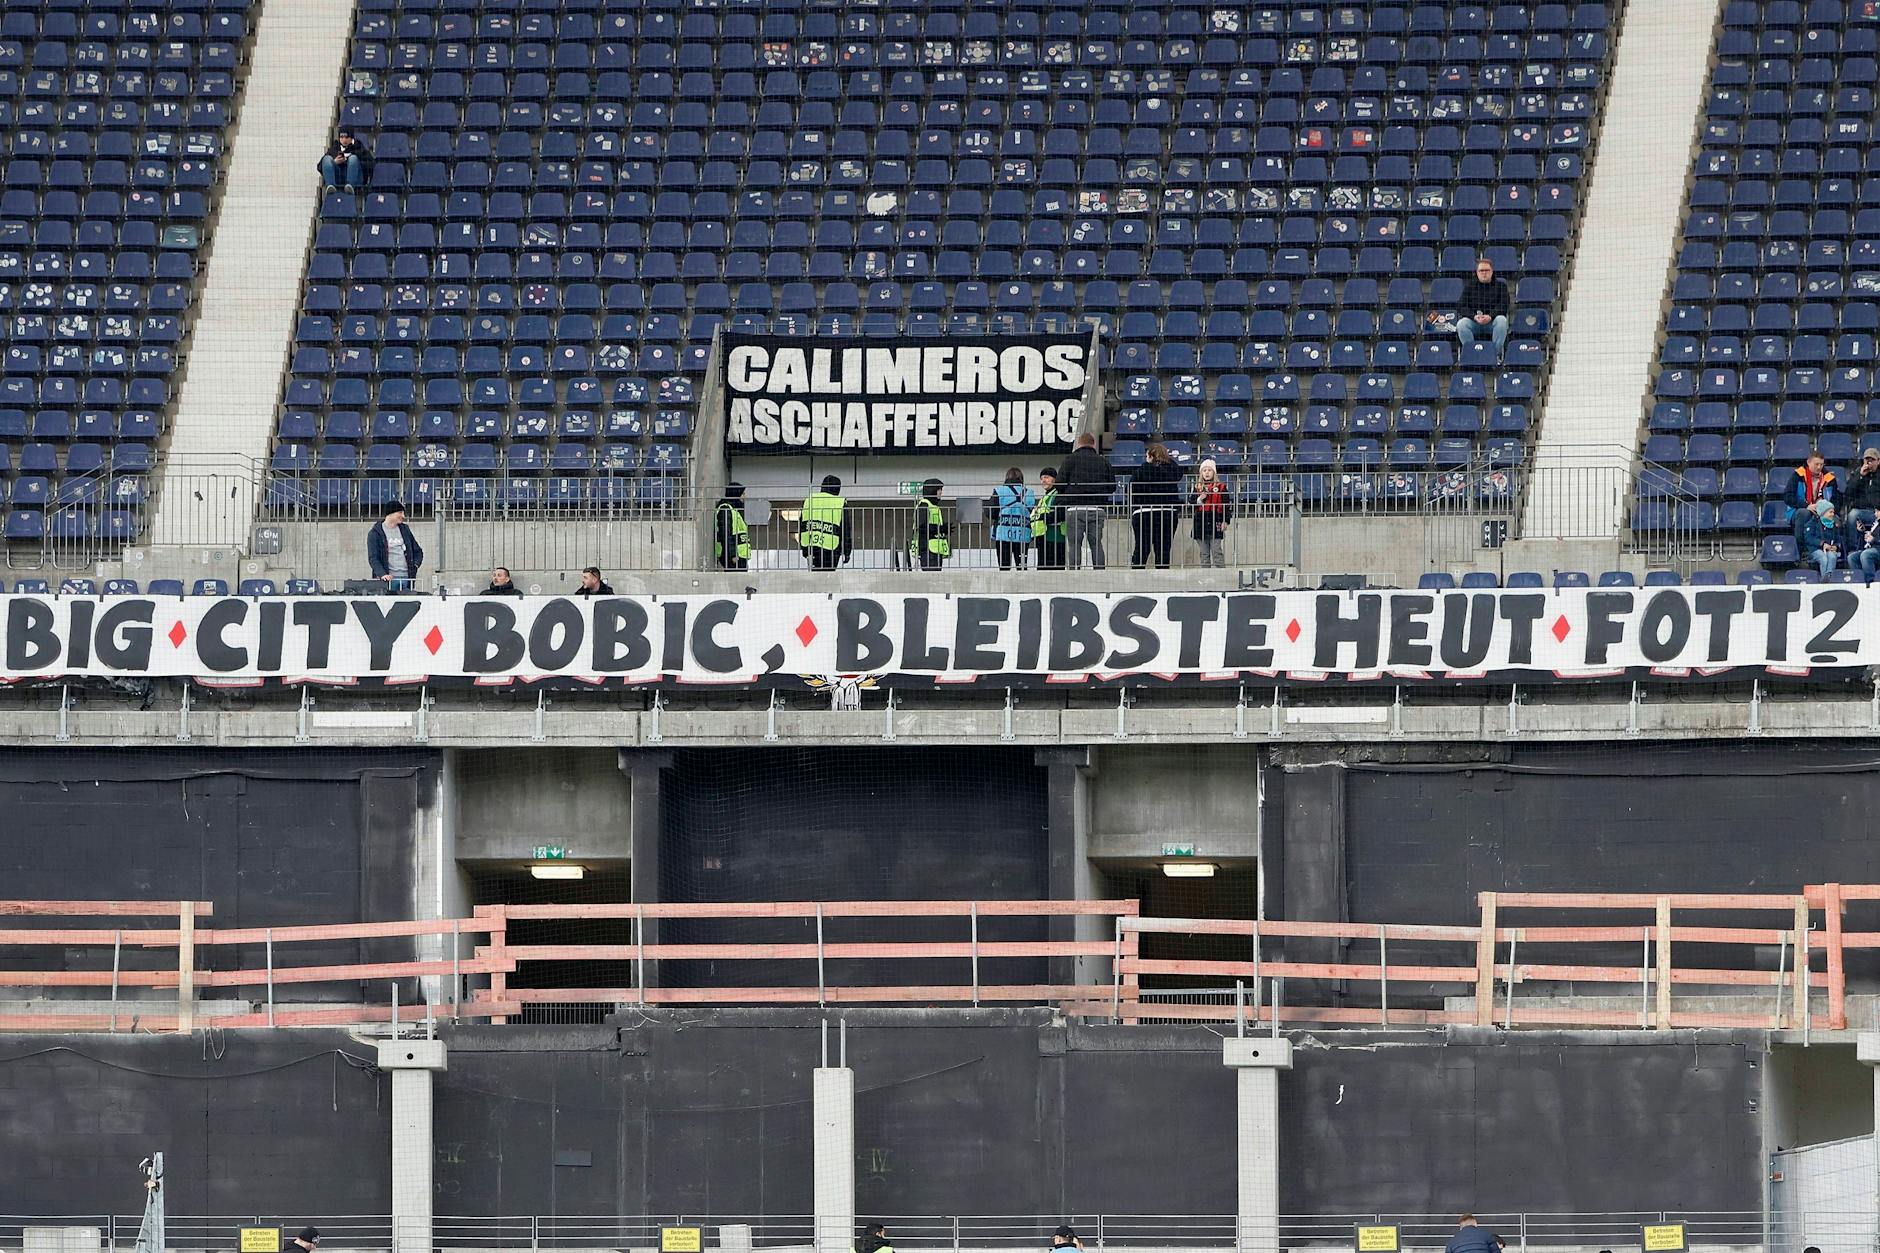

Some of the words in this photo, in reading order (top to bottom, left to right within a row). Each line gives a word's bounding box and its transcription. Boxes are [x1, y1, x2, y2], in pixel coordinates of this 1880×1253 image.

[727, 344, 1085, 395] CALIMEROS
[727, 397, 1086, 448] ASCHAFFENBURG
[6, 597, 156, 672] BIG
[195, 600, 422, 672] CITY
[462, 597, 785, 674] BOBIC,
[835, 595, 1277, 672] BLEIBSTE
[1312, 593, 1546, 669] HEUT
